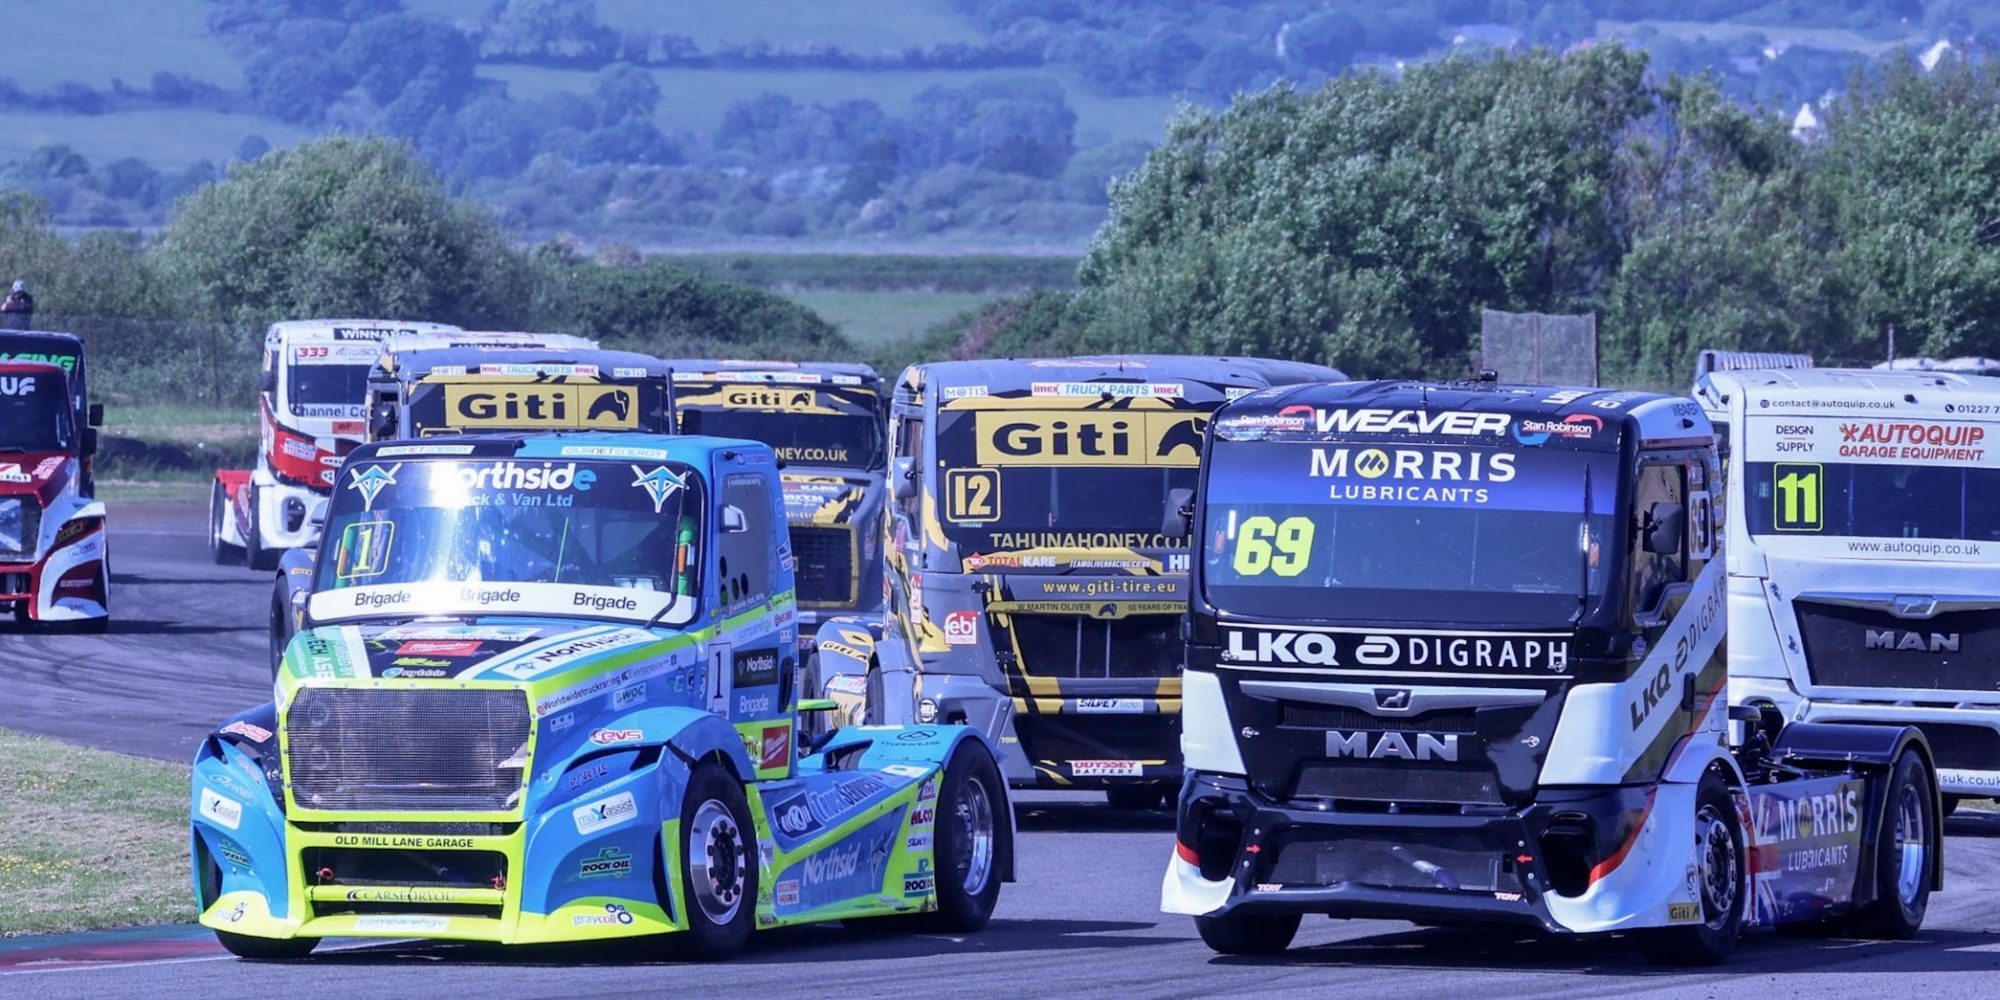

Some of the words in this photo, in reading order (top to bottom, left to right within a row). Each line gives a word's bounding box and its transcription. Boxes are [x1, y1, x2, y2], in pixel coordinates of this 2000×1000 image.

[299, 347, 329, 358] 333
[506, 367, 537, 375] TRUCK
[1064, 383, 1105, 396] TRUCK
[1109, 384, 1149, 396] PARTS
[458, 392, 565, 420] Giti
[729, 392, 780, 405] Giti
[1772, 399, 1896, 410] contact@autoquip.co.uk
[1958, 404, 1990, 413] 01227
[1316, 409, 1511, 435] WEAVER
[1523, 419, 1545, 432] Stan
[1546, 420, 1592, 433] Robinson
[1776, 424, 1814, 435] DESIGN
[992, 421, 1129, 456] Giti
[1858, 423, 1985, 446] AUTOQUIP
[1776, 442, 1814, 452] SUPPLY
[1839, 445, 1897, 459] GARAGE
[1901, 446, 1985, 462] EQUIPMENT
[1309, 448, 1516, 482] MORRIS
[494, 494, 506, 506] &
[512, 493, 541, 506] Van
[546, 493, 573, 507] Ltd
[955, 475, 991, 515] 12
[1330, 485, 1488, 503] LUBRICANTS
[1778, 472, 1817, 523] 11
[352, 529, 373, 571] 1
[1233, 515, 1316, 577] 69
[1848, 541, 1981, 556] www.autoquip.co.uk
[1043, 580, 1177, 595] www.giti-tire.eu
[355, 589, 412, 607] Brigade
[460, 589, 521, 604] Brigade
[573, 591, 637, 611] Brigade
[1027, 602, 1058, 612] MARTIN
[1061, 603, 1091, 612] OLIVER
[1138, 603, 1161, 612] YEARS
[945, 611, 978, 636] febi
[1865, 629, 1960, 651] MAN
[1229, 631, 1340, 666] LKQ
[1409, 637, 1568, 668] DIGRAPH
[713, 650, 724, 699] 1
[740, 694, 769, 717] Brigade
[1630, 663, 1672, 732] LKQ
[1326, 730, 1458, 762] MAN
[1074, 761, 1136, 769] ODYSSEY
[1778, 790, 1858, 841] MORRIS
[335, 836, 360, 846] OLD
[361, 836, 389, 847] MILL
[393, 837, 423, 847] LANE
[426, 837, 474, 848] GARAGE
[582, 861, 611, 873] ROCK
[612, 859, 630, 869] OIL
[1788, 844, 1849, 871] LUBRICANTS
[1257, 883, 1283, 892] TOW
[1670, 906, 1691, 920] Giti
